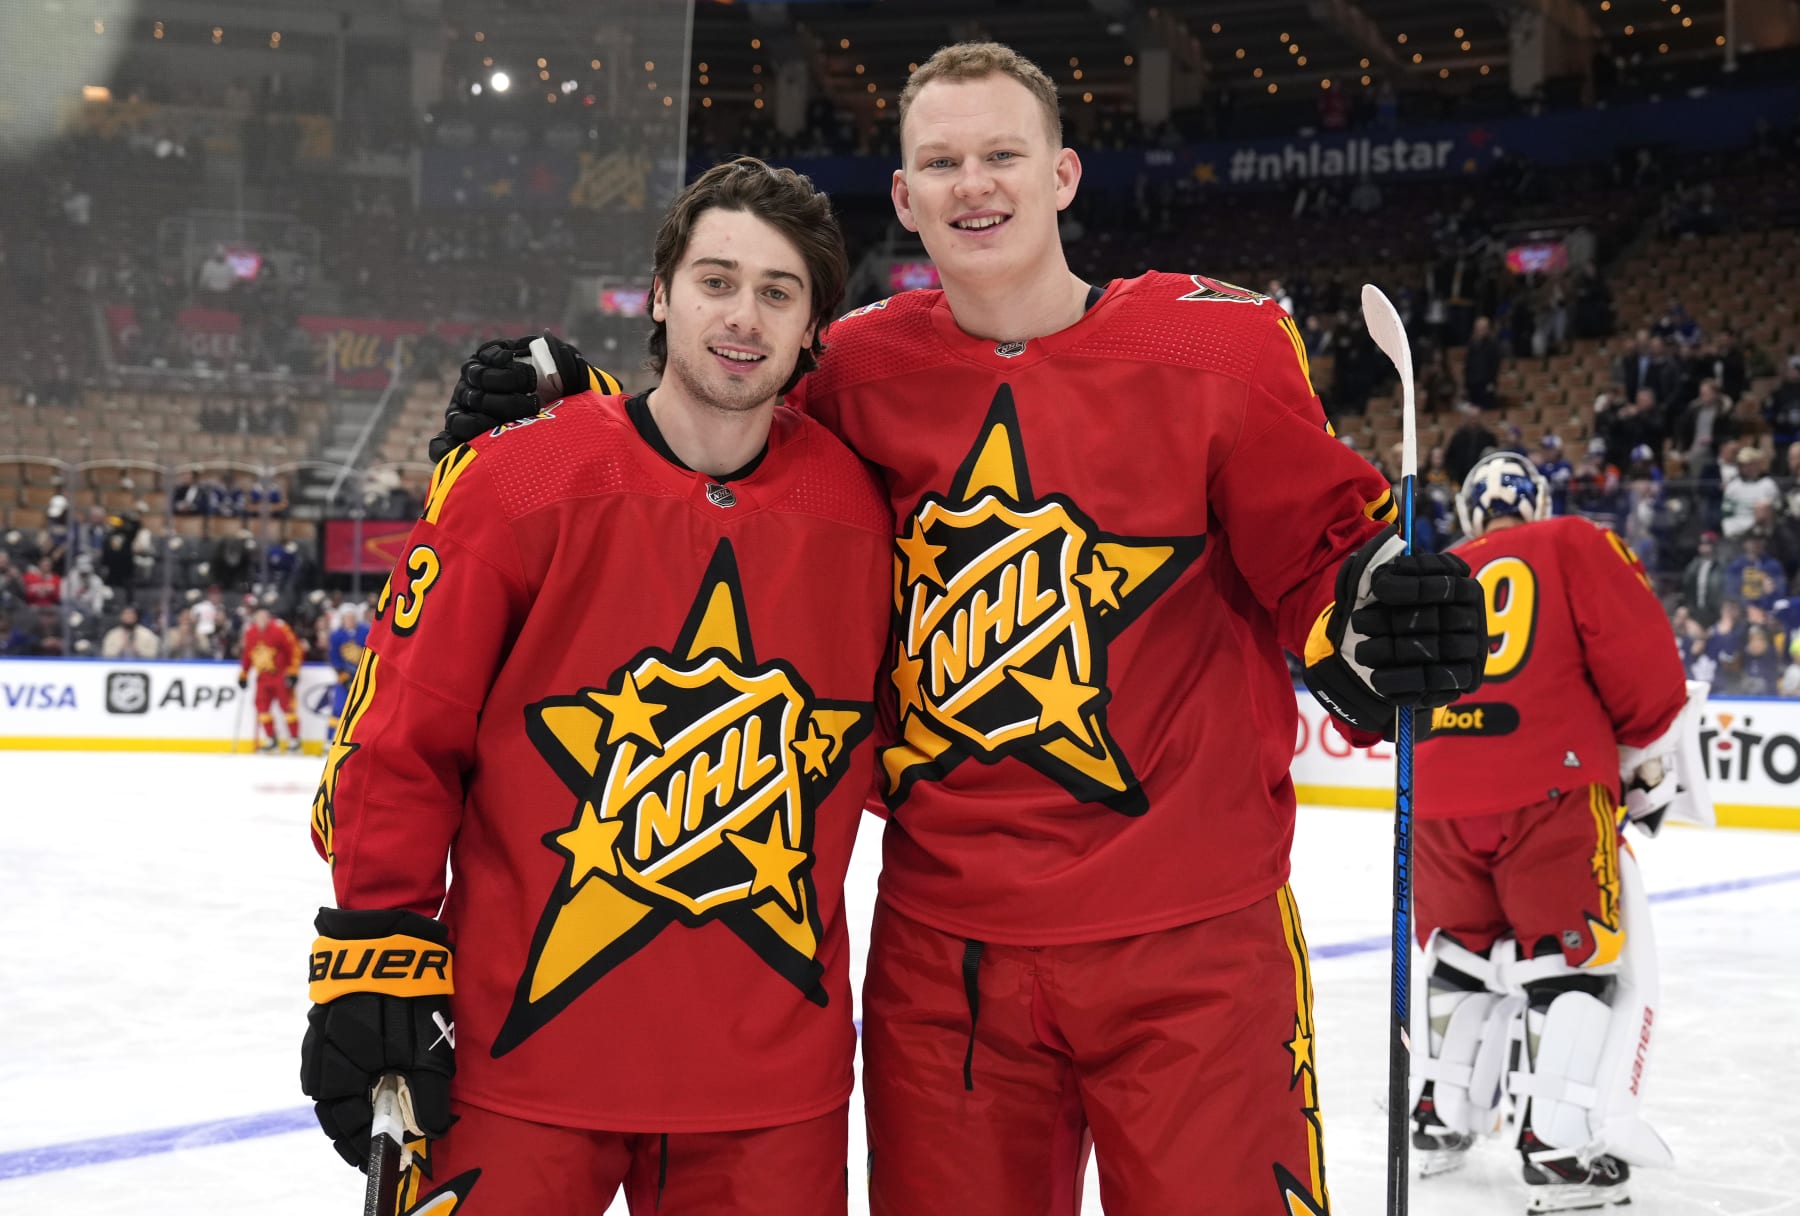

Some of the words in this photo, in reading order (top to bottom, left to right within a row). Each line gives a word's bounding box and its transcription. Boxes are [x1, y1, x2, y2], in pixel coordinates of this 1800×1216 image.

[1229, 138, 1454, 182] #nhlallstar
[932, 550, 1057, 697] NHL
[2, 683, 77, 708] VISA
[1317, 690, 1358, 725] TRUE
[634, 715, 777, 860] NHL
